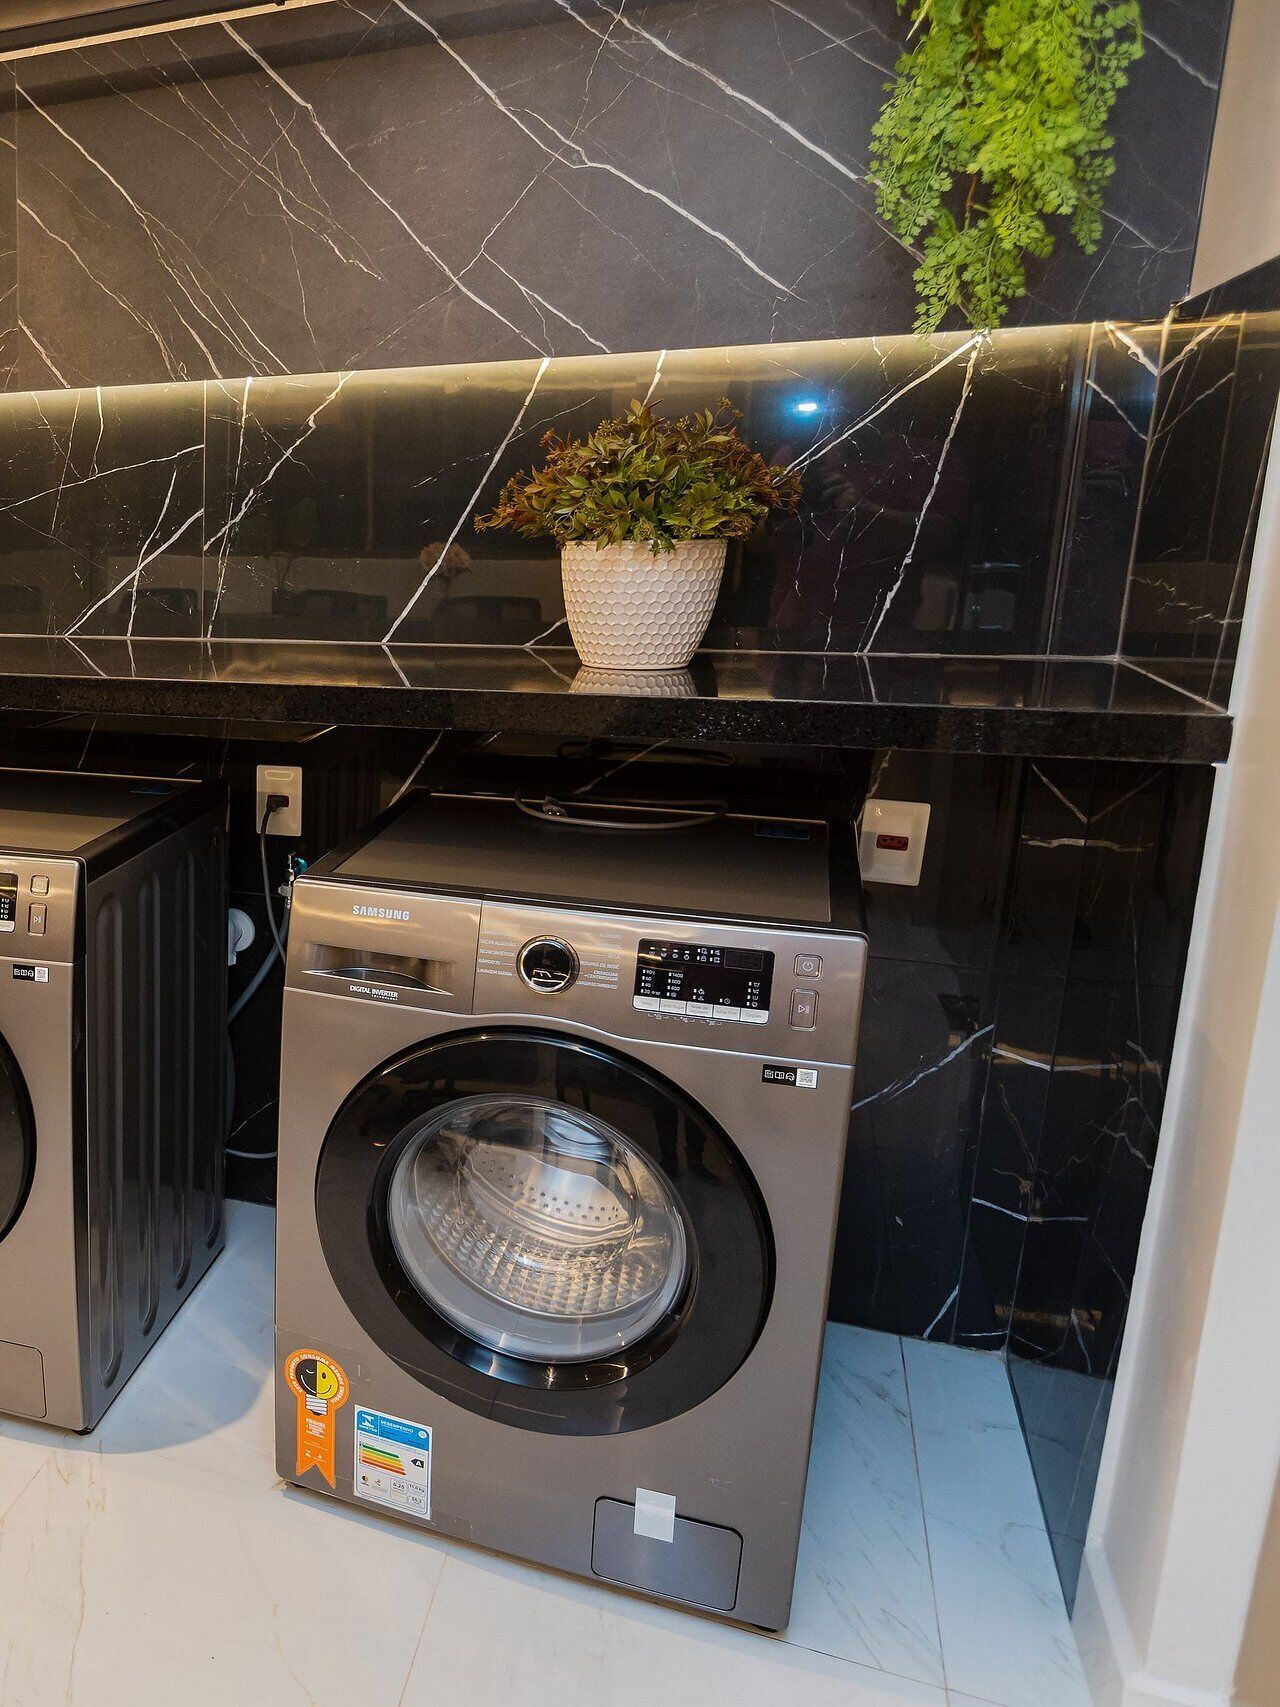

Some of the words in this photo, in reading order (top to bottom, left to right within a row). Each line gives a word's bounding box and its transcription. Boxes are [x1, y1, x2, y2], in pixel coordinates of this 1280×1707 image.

[352, 905, 410, 921] SAMSUNG
[350, 984, 371, 995] DIGITAL
[371, 988, 399, 998] INVERTER
